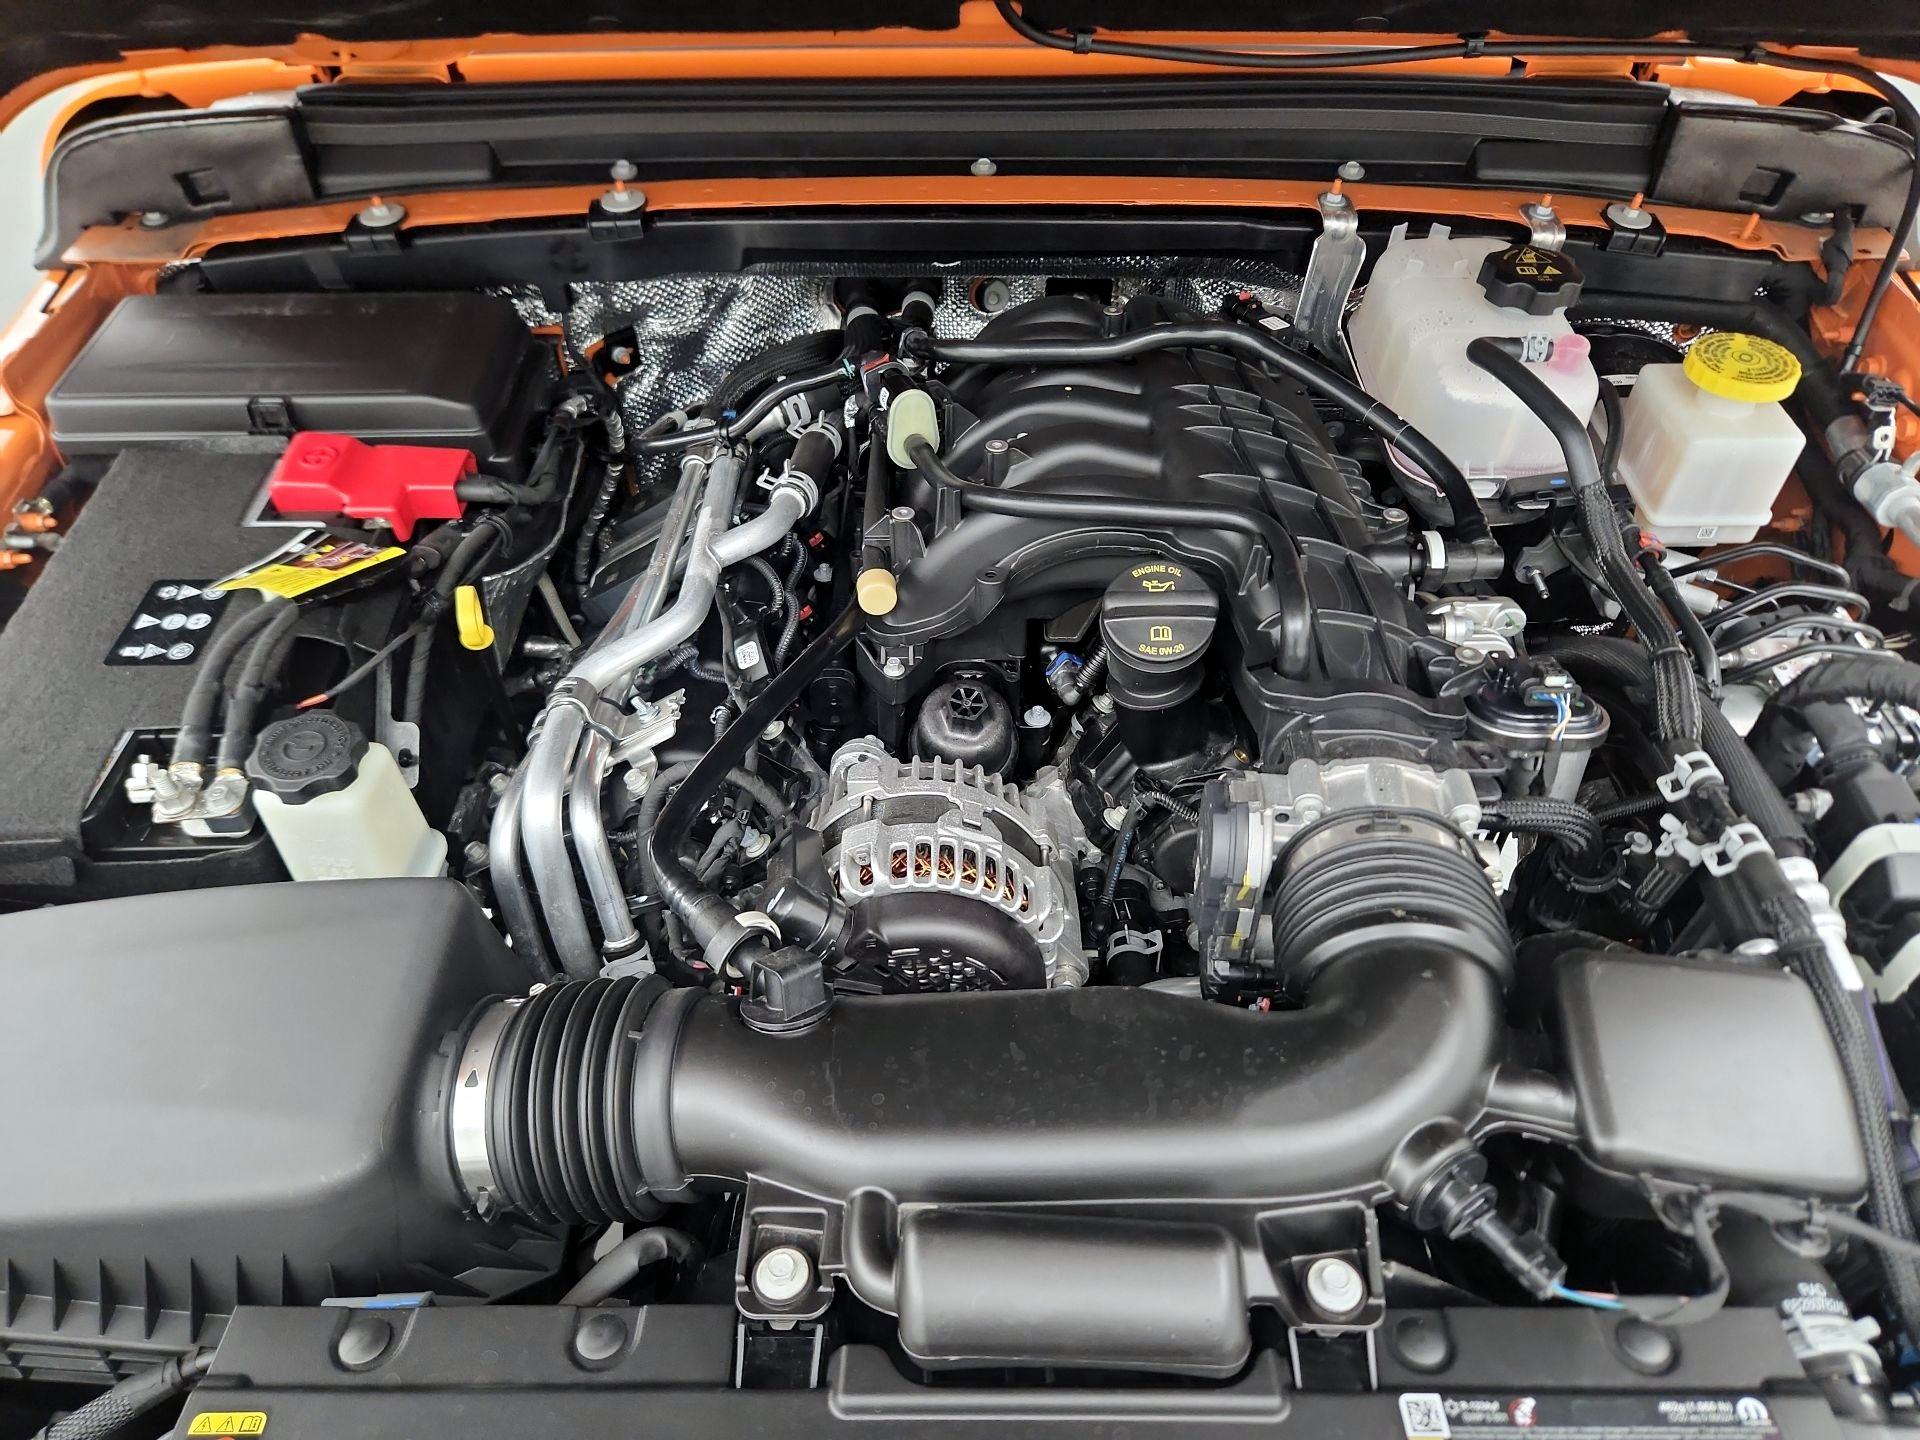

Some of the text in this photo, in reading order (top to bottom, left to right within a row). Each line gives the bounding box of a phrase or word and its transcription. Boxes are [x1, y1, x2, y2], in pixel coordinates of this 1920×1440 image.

[1131, 565, 1183, 578] ENGINE OIL
[1138, 643, 1158, 655] SAE
